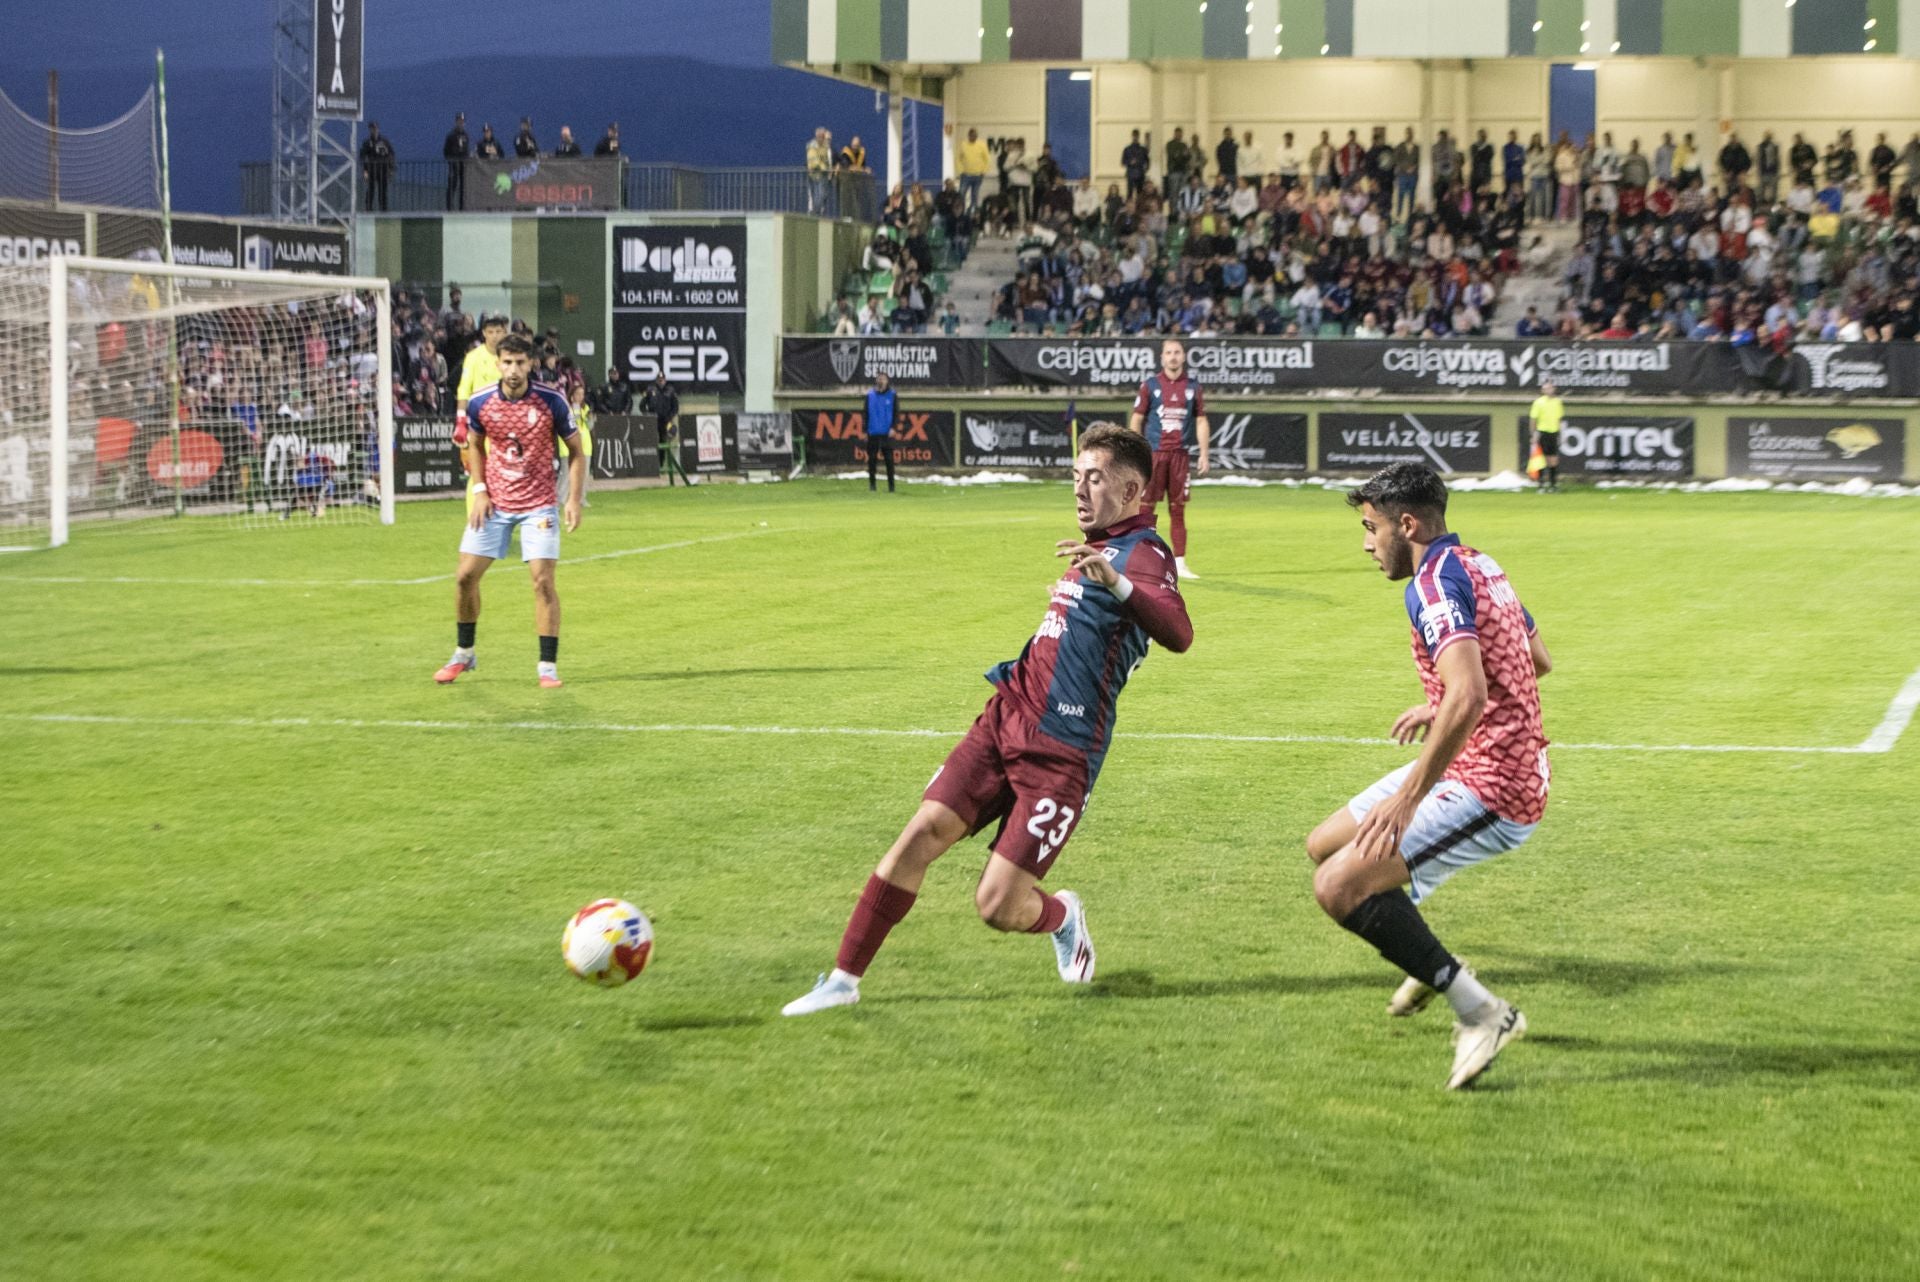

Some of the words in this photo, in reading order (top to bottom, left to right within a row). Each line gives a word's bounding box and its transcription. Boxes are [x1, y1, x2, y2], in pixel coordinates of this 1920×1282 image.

[621, 290, 673, 304] 104.1FM
[685, 290, 713, 304] 1602
[716, 290, 739, 304] OM
[641, 326, 717, 341] CADENA
[628, 346, 730, 381] SER
[864, 343, 937, 362] GIMNÁSTICA
[1038, 340, 1156, 376] cajaviva
[1187, 341, 1315, 373] cajarural
[1383, 342, 1506, 377] cajaviva
[1537, 342, 1671, 372] cajarural
[1187, 368, 1275, 384] Fundación
[1437, 371, 1507, 388] Segovia
[1341, 421, 1480, 448] VELÁZQUEZ
[1057, 702, 1084, 717] 1928
[1027, 797, 1075, 847] 23
